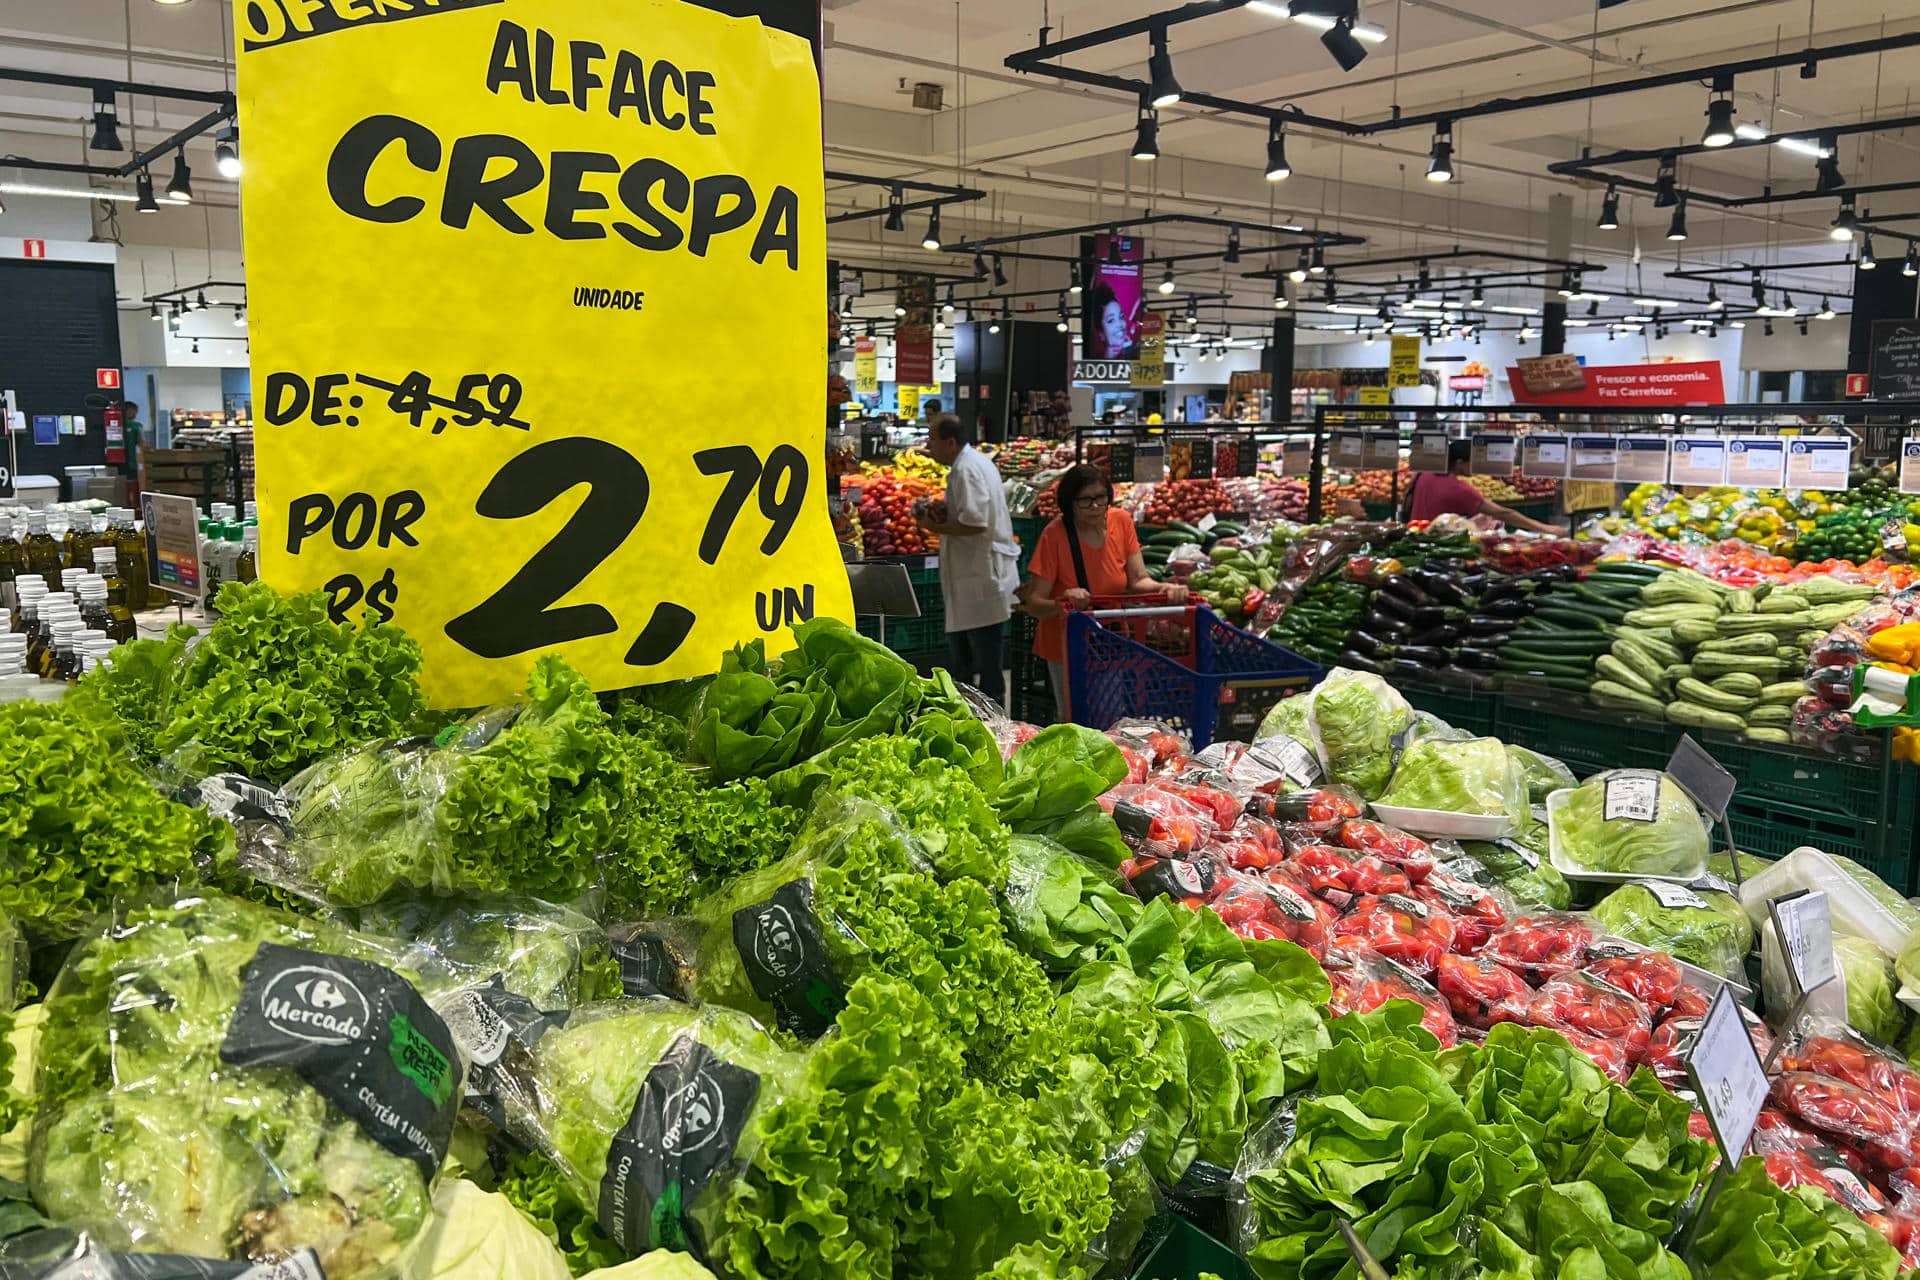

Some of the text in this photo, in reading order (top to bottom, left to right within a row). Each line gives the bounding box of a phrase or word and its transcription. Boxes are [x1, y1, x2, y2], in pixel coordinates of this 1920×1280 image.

[487, 19, 716, 135] ALFACE
[327, 114, 798, 271] CRESPA
[573, 286, 644, 311] UNIDADE
[264, 371, 364, 427] DE:
[1596, 371, 1710, 384] Frescor e economia.
[1599, 386, 1677, 397] Faz Carrefour.
[286, 490, 425, 554] POR
[323, 568, 399, 631] R$
[755, 584, 815, 632] UN
[264, 997, 361, 1039] Mercado
[407, 1028, 448, 1078] ALFACE
[399, 1121, 409, 1134] 1
